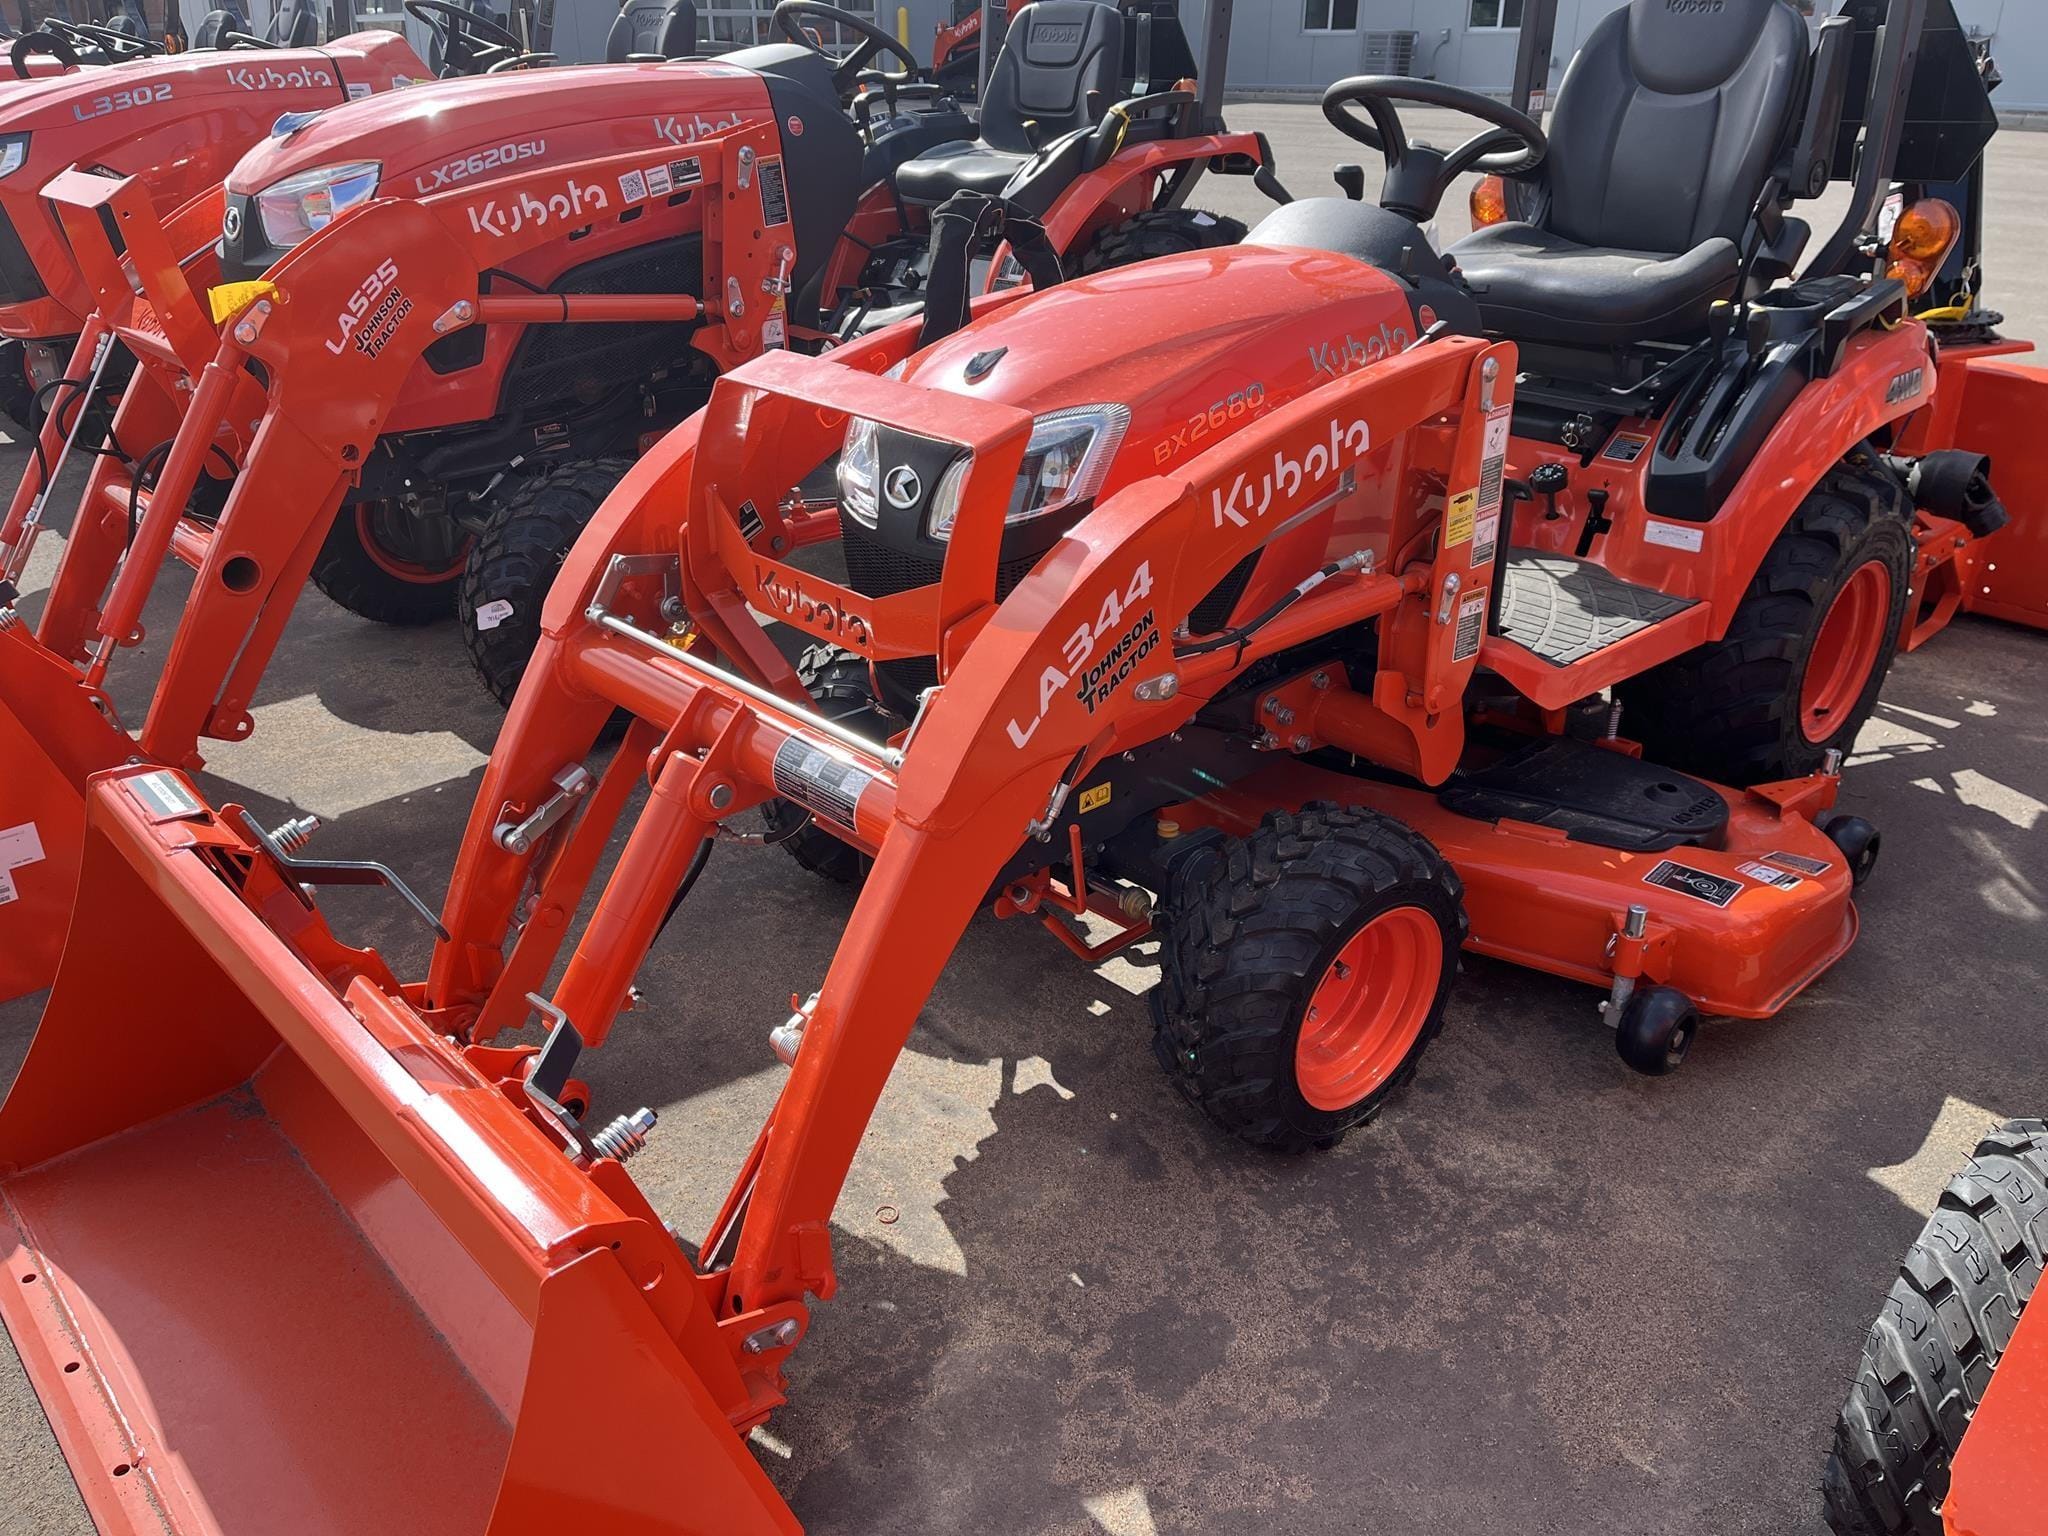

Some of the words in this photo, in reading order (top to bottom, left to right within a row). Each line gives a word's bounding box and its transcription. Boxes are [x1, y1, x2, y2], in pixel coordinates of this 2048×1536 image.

[954, 16, 978, 37] Kubota
[1035, 26, 1077, 42] Kubota
[72, 83, 173, 121] L3302
[226, 65, 332, 90] Kubota
[415, 139, 546, 194] LX2620SU
[467, 179, 608, 237] Kubota
[325, 257, 398, 354] LA535
[354, 286, 402, 351] JOHNSON
[363, 298, 414, 360] TRACTOR
[1309, 323, 1409, 376] Kubota
[1885, 368, 1921, 404] 4WD
[1153, 382, 1265, 466] BX2680
[1212, 418, 1370, 528] Kubota
[755, 565, 867, 646] Kubota
[1006, 560, 1154, 749] LA344
[1076, 609, 1155, 700] JOHNSON
[1082, 629, 1160, 715] TRACTOR
